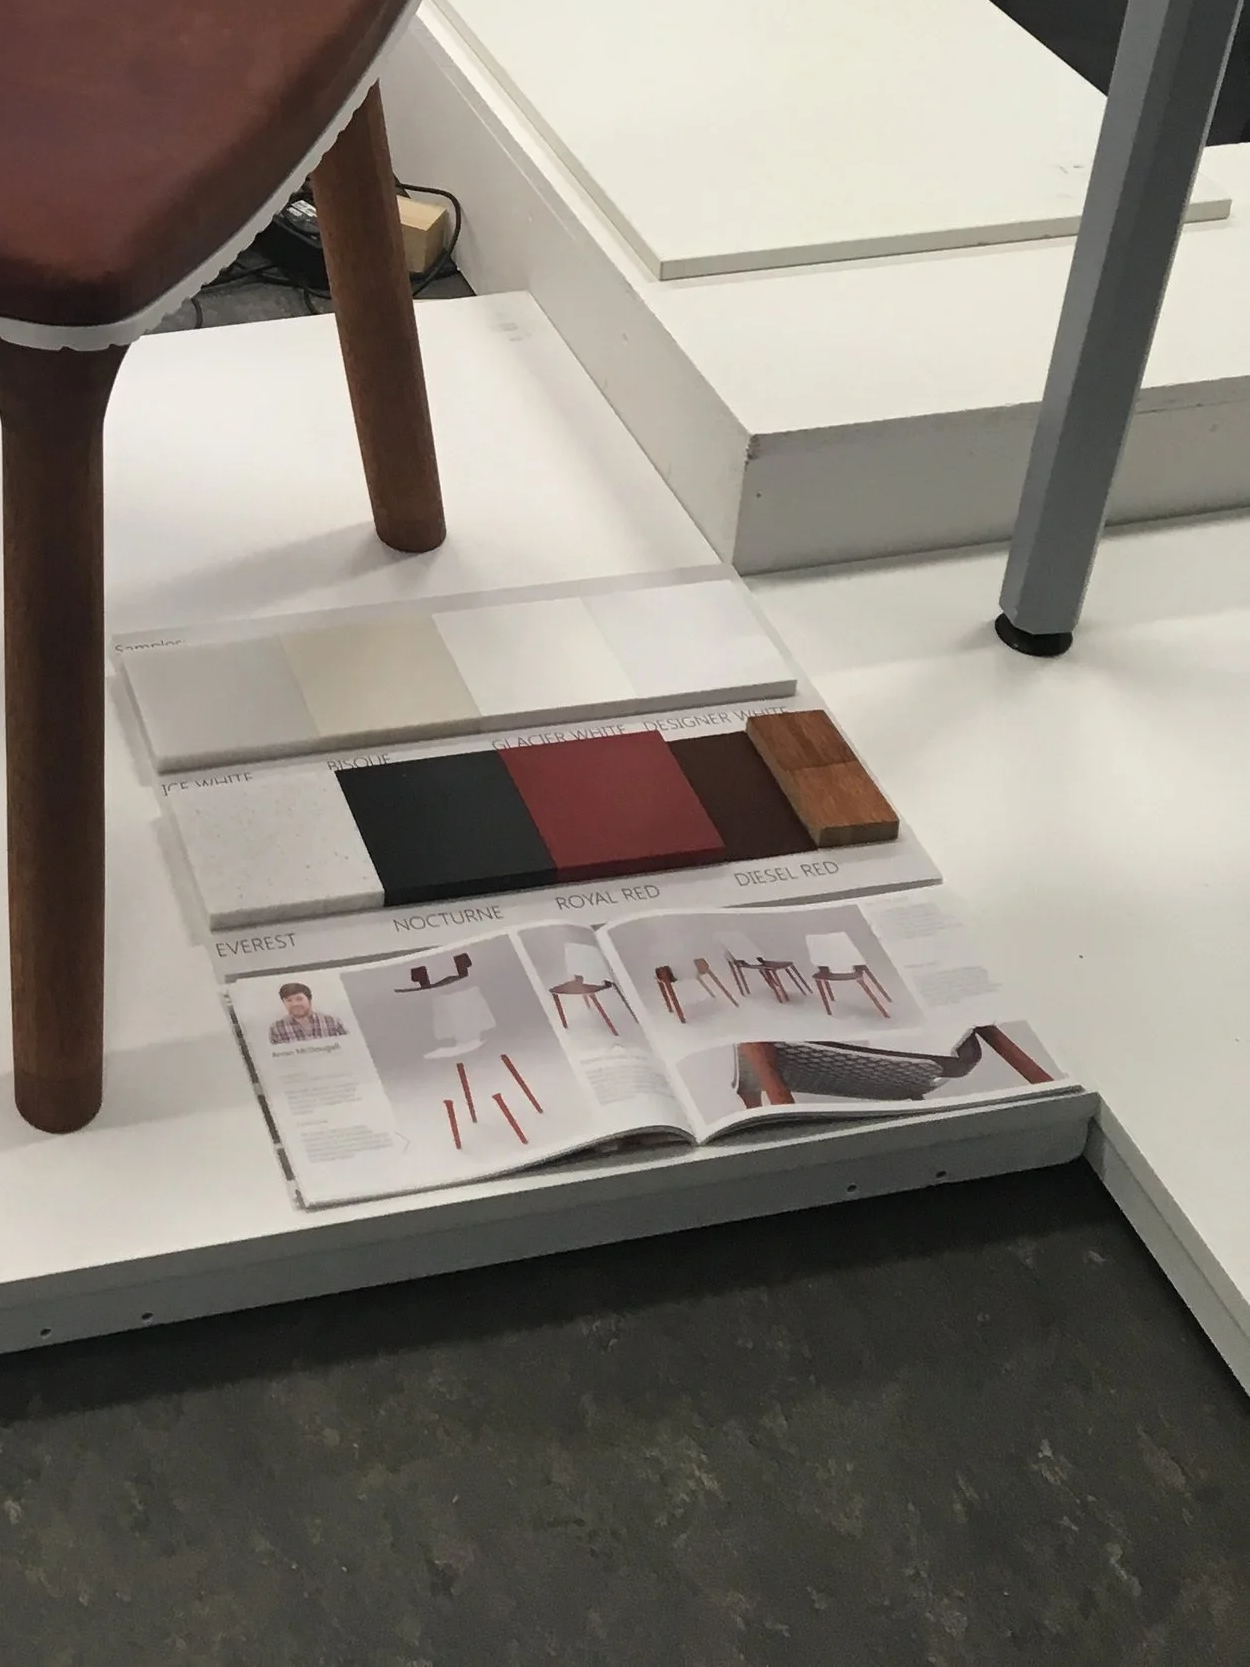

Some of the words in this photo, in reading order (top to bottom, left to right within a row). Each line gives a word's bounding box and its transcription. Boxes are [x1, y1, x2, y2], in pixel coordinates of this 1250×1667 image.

[642, 712, 730, 731] DESIGNER
[735, 867, 798, 887] DIESEL
[800, 860, 839, 878] RED
[555, 891, 617, 910] ROYAL
[622, 885, 660, 901] RED
[393, 905, 504, 932] NOCTURNE
[216, 933, 296, 958] EVEREST
